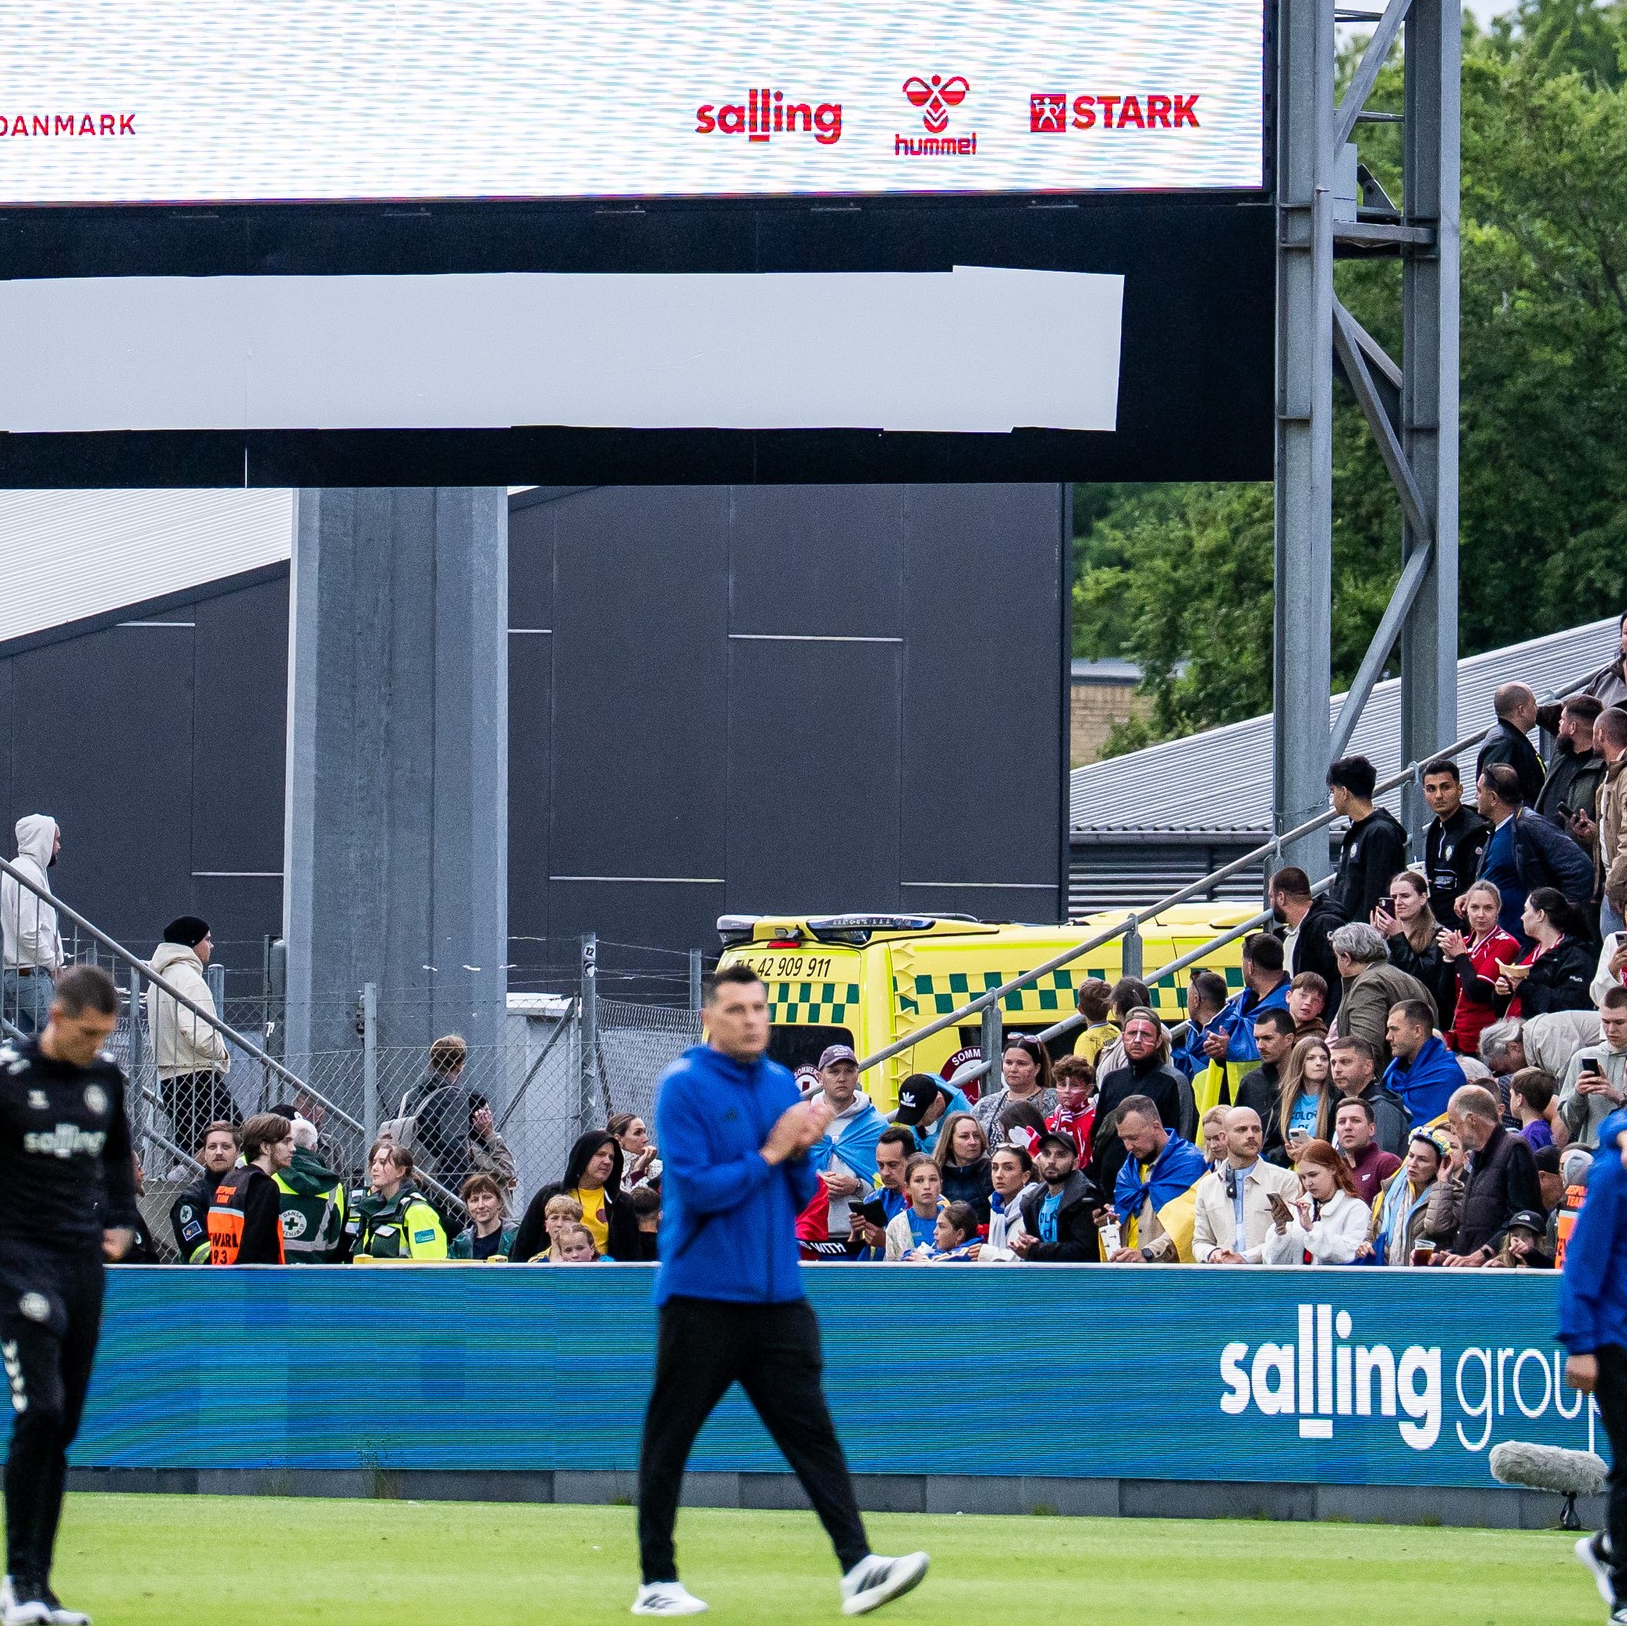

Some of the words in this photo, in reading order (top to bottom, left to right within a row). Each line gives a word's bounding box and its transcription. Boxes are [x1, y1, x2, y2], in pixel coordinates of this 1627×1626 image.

[697, 89, 842, 145] salling
[1073, 95, 1200, 130] STARK
[896, 135, 977, 156] hummel
[757, 957, 774, 977] 42
[777, 957, 803, 977] 909
[806, 957, 832, 978] 911
[951, 1048, 982, 1066] SOMM
[810, 1242, 848, 1254] WITH
[1220, 1304, 1442, 1450] salling
